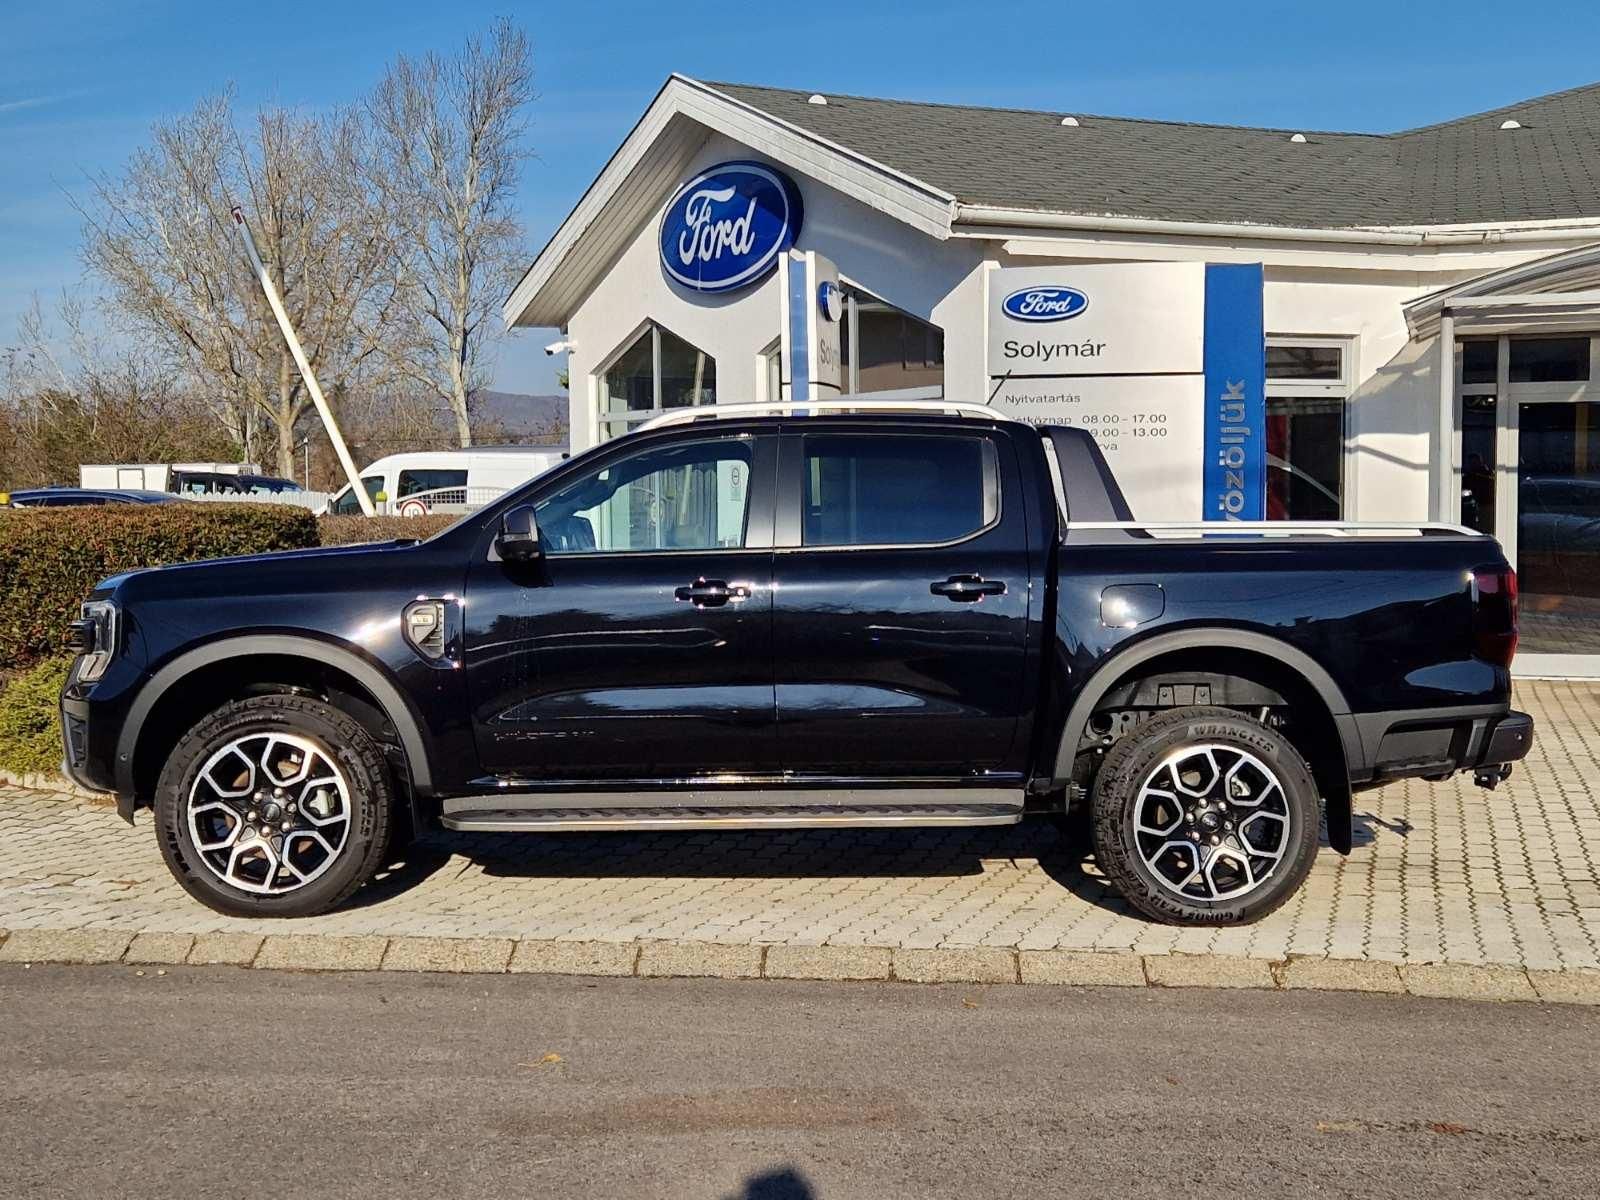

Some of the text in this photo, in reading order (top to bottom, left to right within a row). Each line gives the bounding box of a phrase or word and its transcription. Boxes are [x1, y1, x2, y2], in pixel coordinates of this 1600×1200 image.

[679, 185, 758, 266] Ford
[1020, 291, 1071, 315] Ford
[1004, 338, 1107, 362] Solymár
[1005, 394, 1081, 405] Nyitvatartás
[1082, 414, 1119, 424] 08.00
[1133, 414, 1167, 423] 17.00
[1089, 428, 1119, 438] 9.00
[1133, 428, 1168, 438] 13.00
